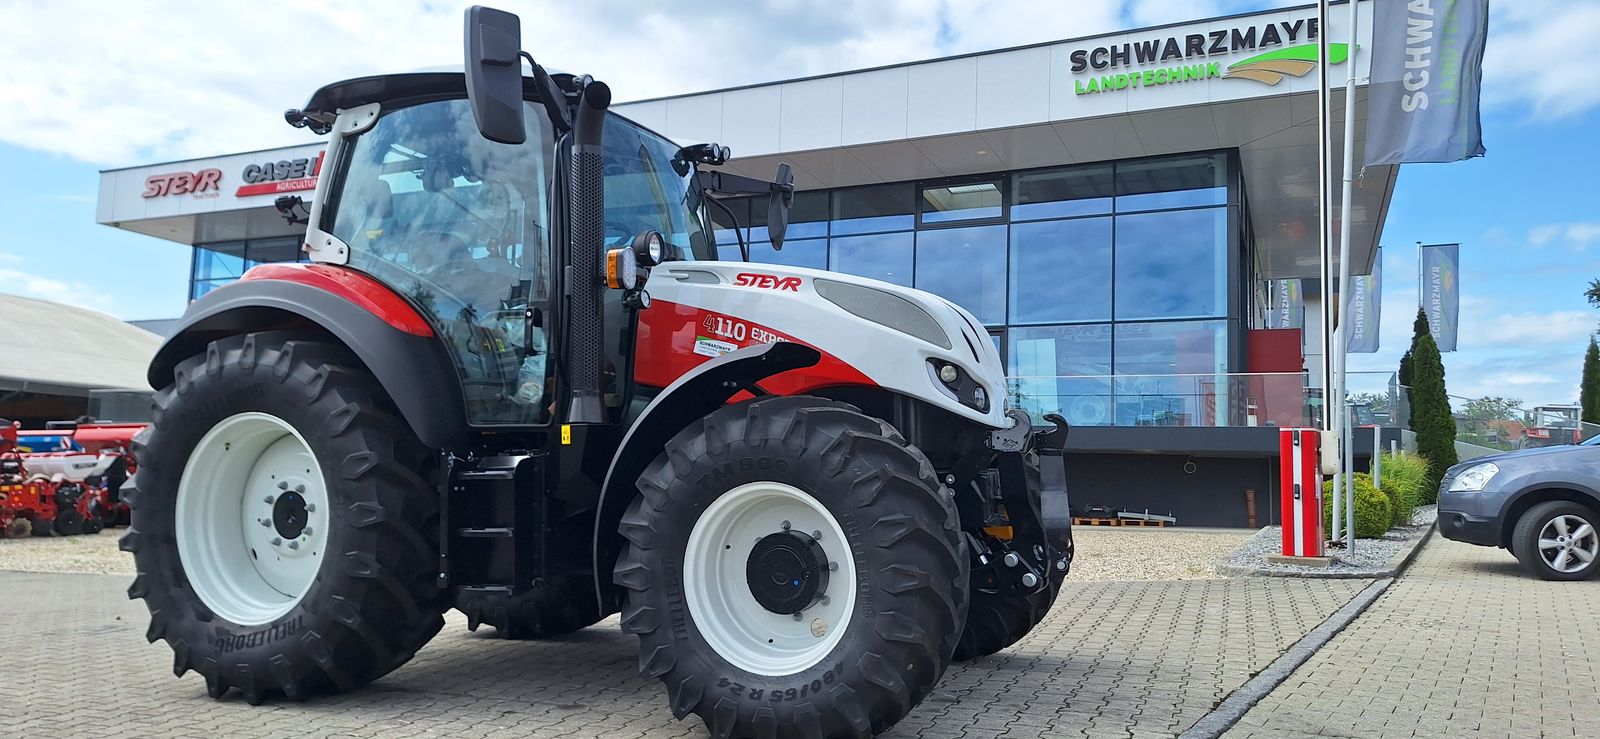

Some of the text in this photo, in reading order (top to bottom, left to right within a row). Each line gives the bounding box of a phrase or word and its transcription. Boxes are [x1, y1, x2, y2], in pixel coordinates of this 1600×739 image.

[1074, 61, 1222, 95] LANDTECHNIK
[142, 168, 222, 198] STEYR
[242, 158, 308, 183] CASE
[731, 273, 802, 292] STEYR
[1432, 266, 1440, 338] SCHWARZMAYR
[702, 314, 746, 341] 4110
[699, 340, 731, 352] SCHWARZMAYR
[214, 615, 305, 654] TRELLEBORG
